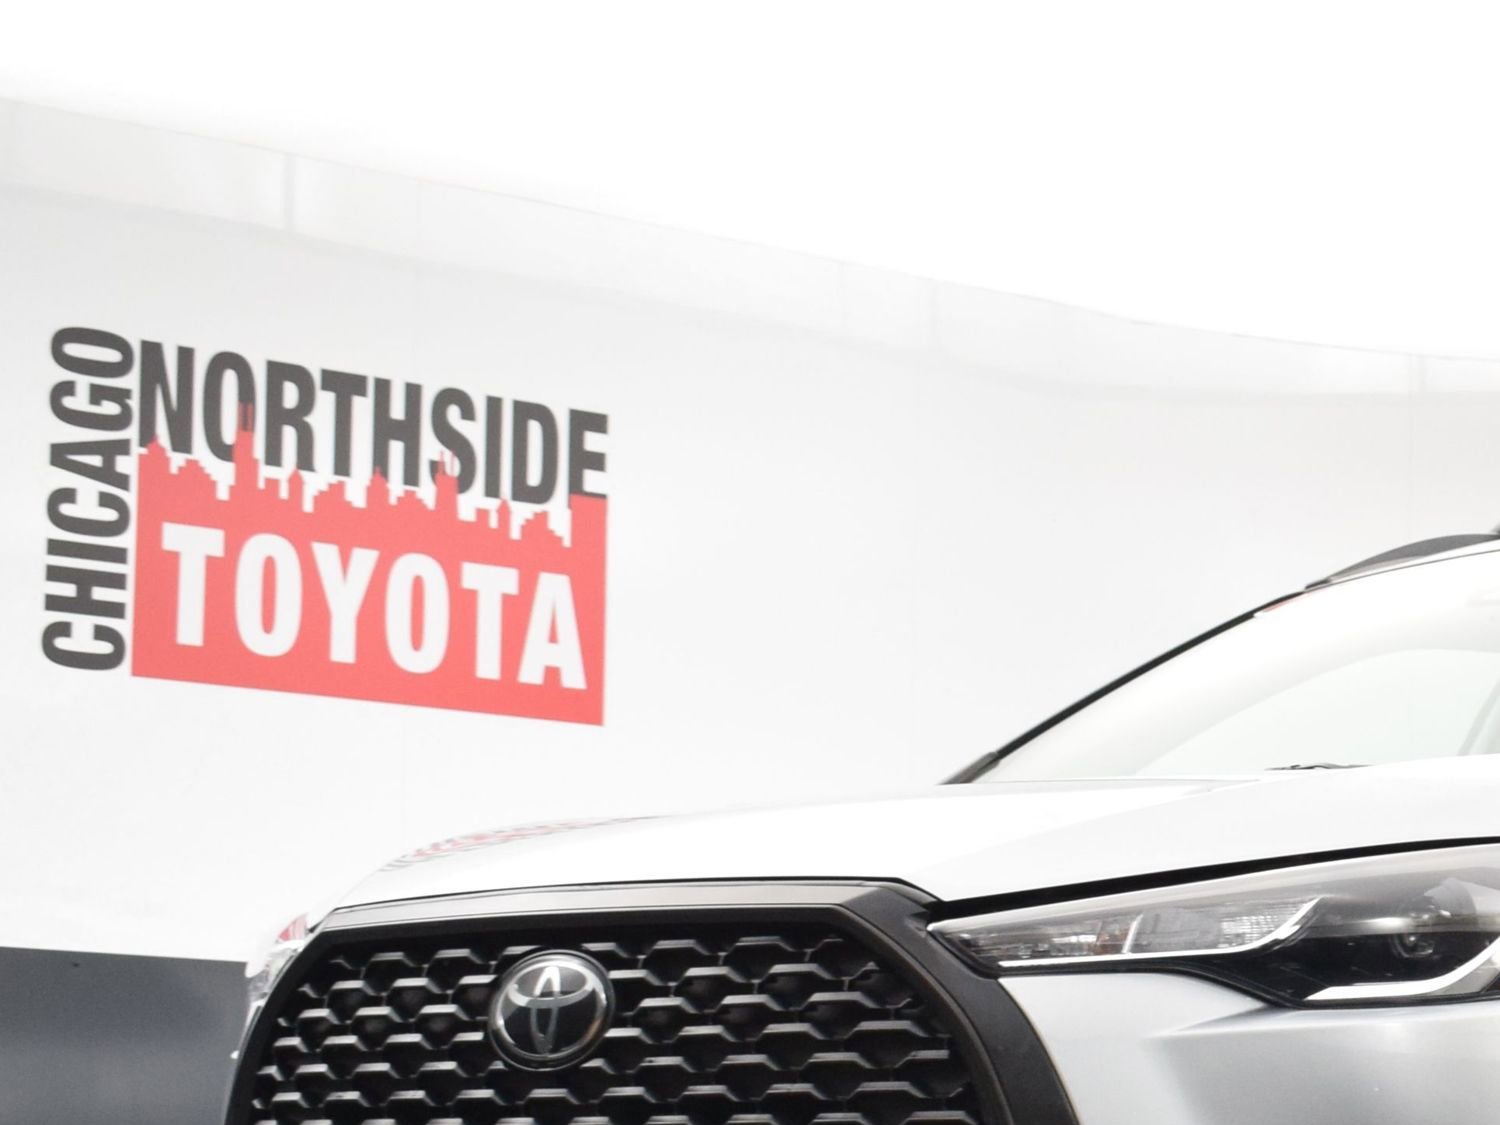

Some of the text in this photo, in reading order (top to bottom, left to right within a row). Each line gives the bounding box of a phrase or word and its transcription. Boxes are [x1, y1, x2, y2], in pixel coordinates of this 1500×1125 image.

[42, 326, 134, 671] CHICAGO
[138, 339, 609, 505] NORTHSIDE
[161, 522, 588, 690] TOYOTA
